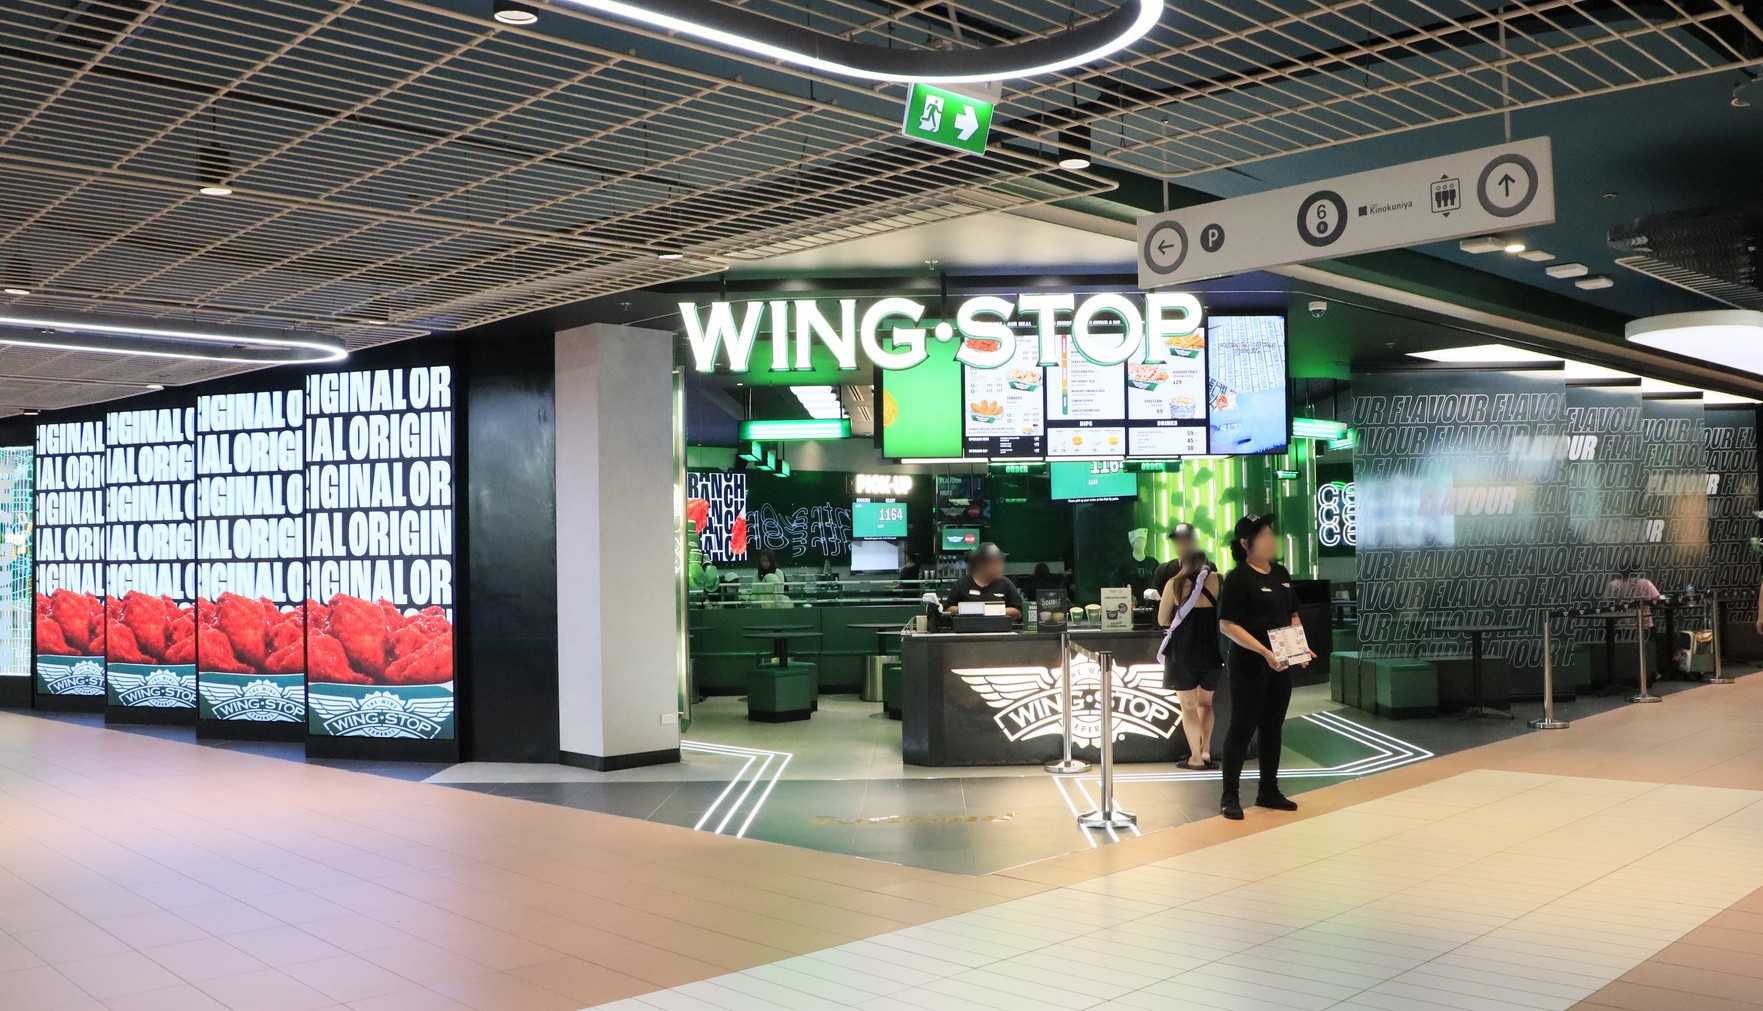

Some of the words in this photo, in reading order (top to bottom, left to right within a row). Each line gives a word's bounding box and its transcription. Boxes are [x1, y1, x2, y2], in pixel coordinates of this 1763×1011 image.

[1317, 204, 1326, 220] 6
[1370, 200, 1413, 215] Kinokuniya
[1208, 228, 1219, 248] P
[408, 366, 452, 410] OR
[1388, 394, 1490, 424] FLAVOUR
[348, 411, 452, 460] ORIGIN
[408, 461, 452, 506] OR
[856, 474, 912, 494] PICK-UP
[879, 507, 904, 521] 1164
[1416, 486, 1518, 516] FLAVOUR
[348, 510, 452, 556] ORIGIN
[1396, 550, 1497, 579] FLAVOUR
[410, 559, 452, 605] OR
[1428, 578, 1530, 608] FLAVOUR
